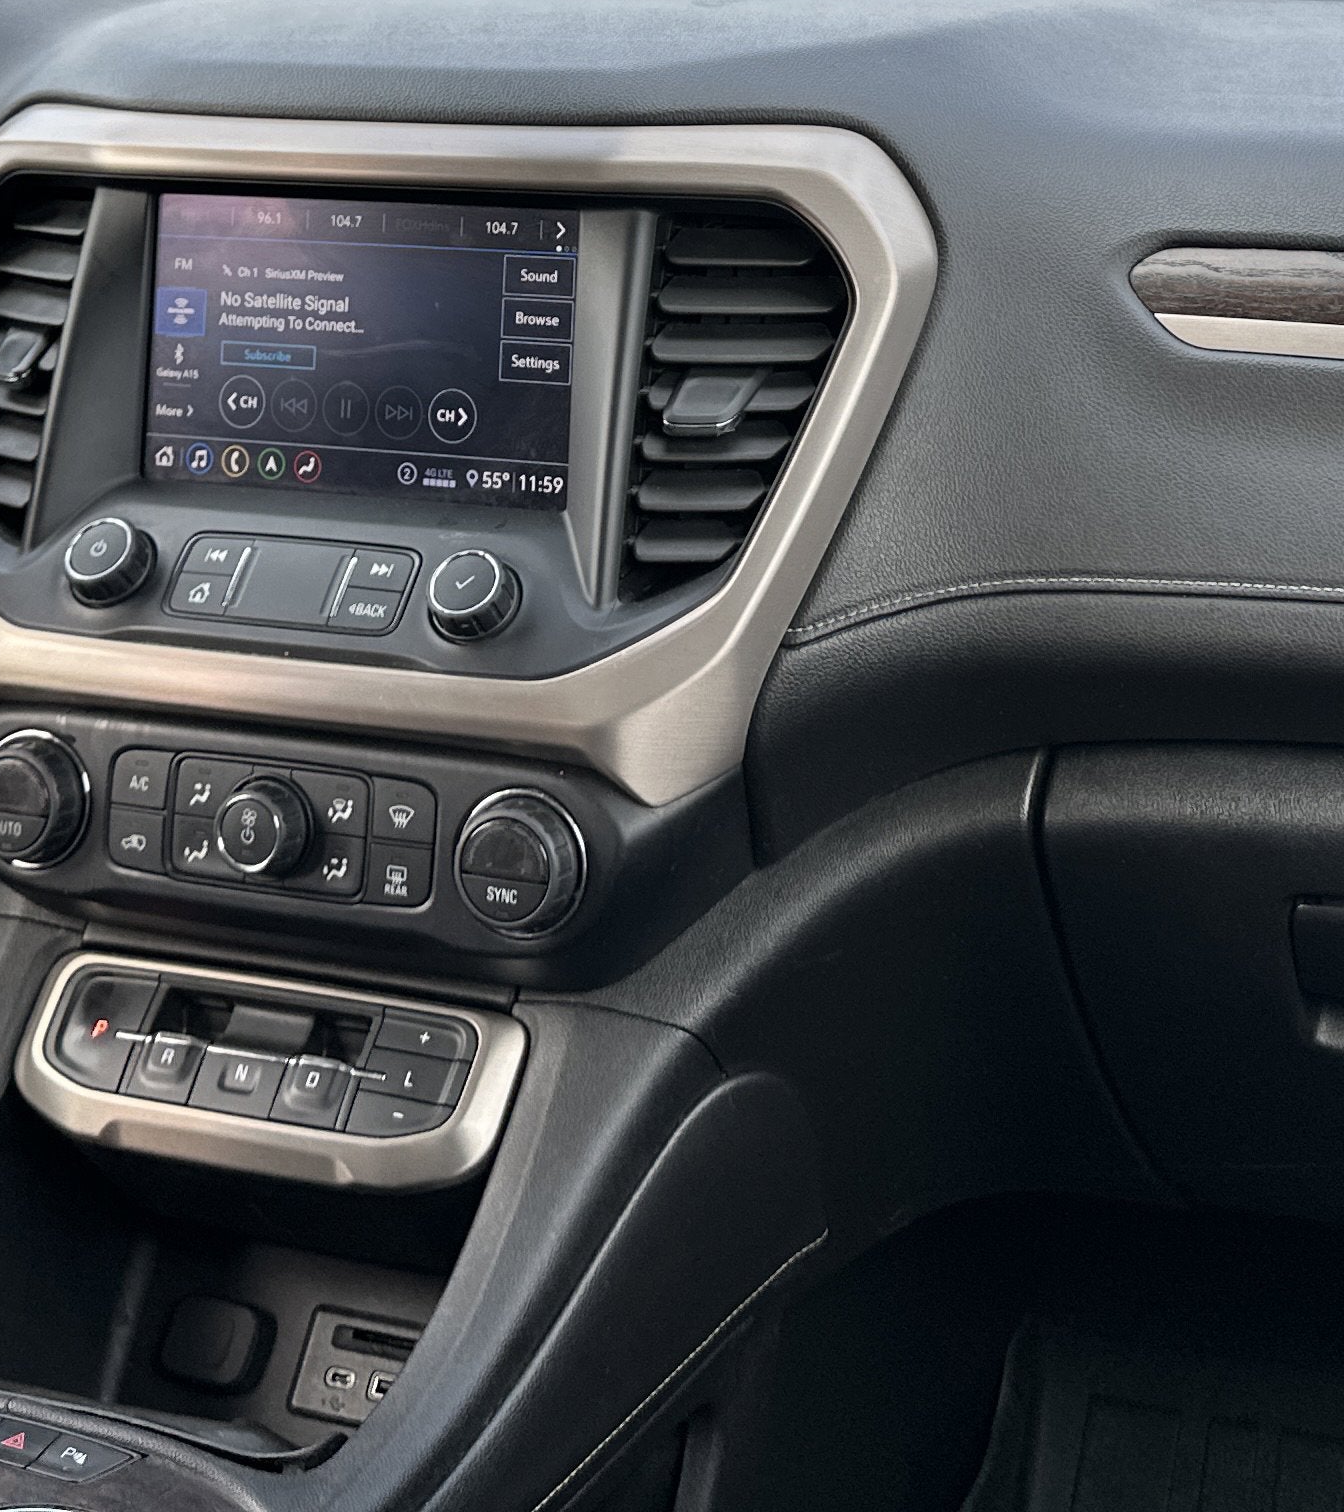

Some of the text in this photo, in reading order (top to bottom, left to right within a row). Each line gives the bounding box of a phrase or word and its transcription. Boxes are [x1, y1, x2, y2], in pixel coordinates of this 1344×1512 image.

[257, 211, 281, 225] 96.1
[330, 214, 363, 228] 104.7
[485, 221, 518, 235] 104.7
[174, 257, 193, 270] FM
[237, 266, 251, 278] Ch
[265, 268, 306, 280] SiriusXM
[308, 269, 344, 282] Preview
[520, 268, 558, 283] Sound
[220, 291, 350, 315] No Satellite Signal
[219, 312, 285, 332] Attempting
[288, 315, 303, 330] To
[515, 311, 560, 327] Browse
[244, 348, 292, 363] Subscribe
[511, 354, 560, 373] Settings
[240, 395, 257, 409] CH
[156, 404, 183, 417] More
[436, 408, 455, 422] CH
[424, 467, 454, 479] 4G LTE
[519, 474, 564, 494] 11:59
[355, 602, 387, 618] BACK
[129, 775, 149, 792] A/C
[384, 883, 408, 897] REAR
[486, 885, 518, 905] SYNC
[90, 1018, 109, 1038] P
[160, 1047, 176, 1065] R
[234, 1063, 249, 1082] N
[305, 1070, 321, 1088] D
[404, 1070, 413, 1088] L
